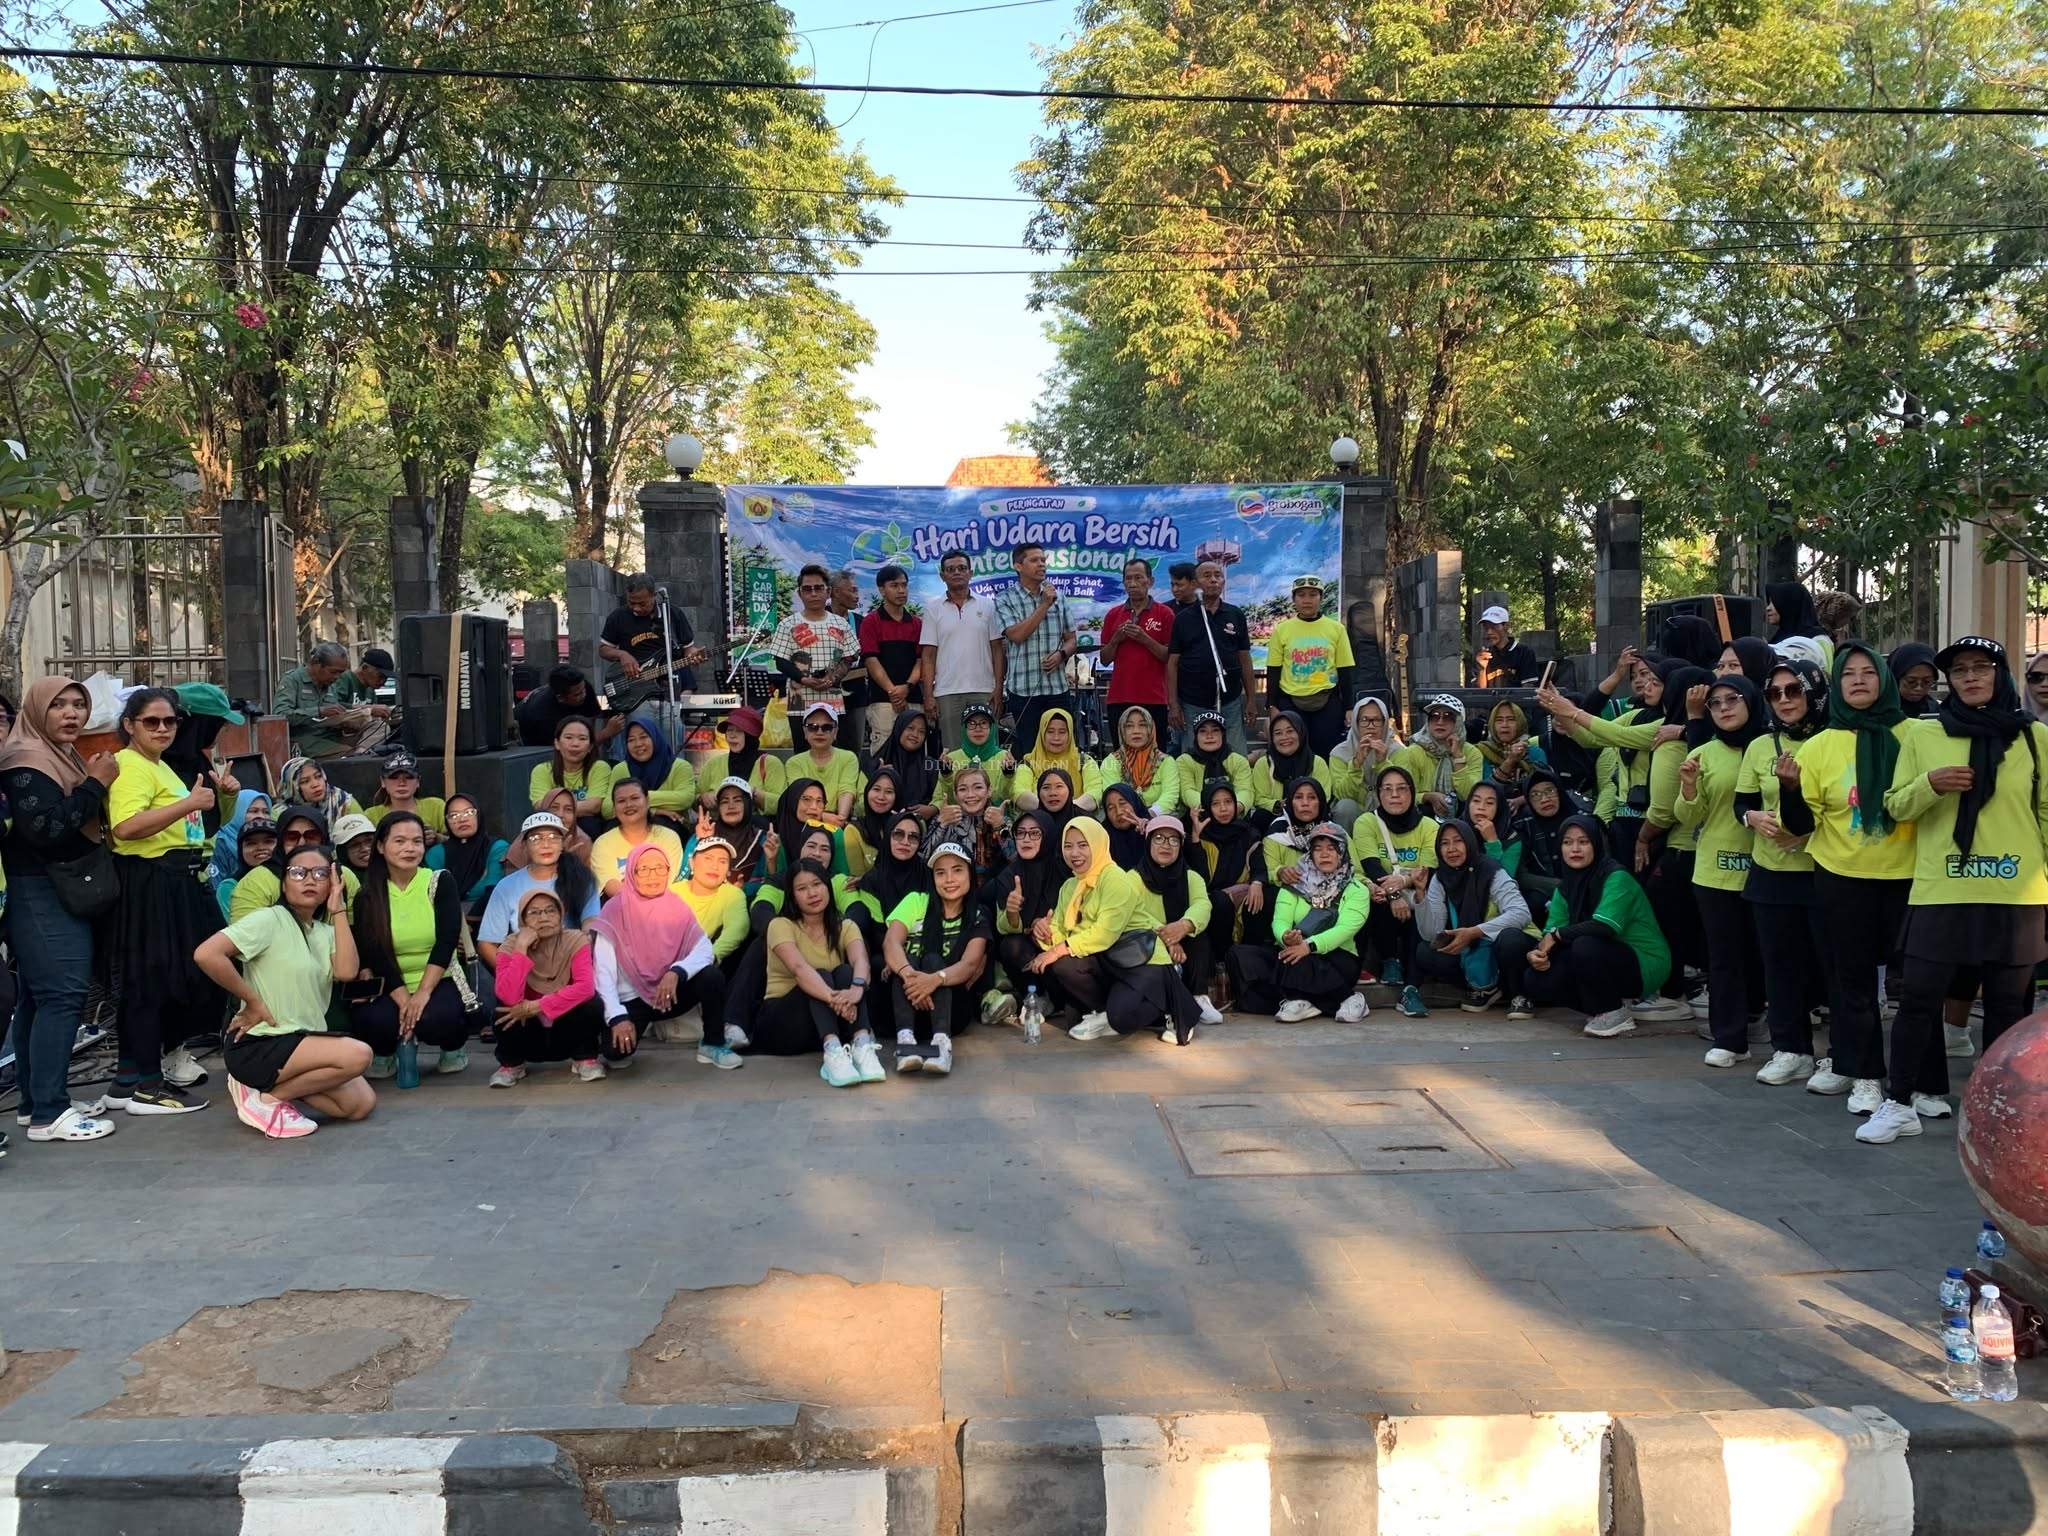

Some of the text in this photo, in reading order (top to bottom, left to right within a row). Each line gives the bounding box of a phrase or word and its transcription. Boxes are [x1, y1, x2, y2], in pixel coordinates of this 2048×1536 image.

[1007, 498, 1065, 512] PERINGATAN
[1268, 500, 1322, 511] grobogan
[913, 514, 1178, 561] Hari Udara Bersih
[753, 582, 772, 592] CAR
[1072, 576, 1104, 588] Sehat,
[1073, 586, 1095, 597] Baik
[460, 650, 470, 710] MONJAYA
[713, 697, 736, 705] KORG
[1946, 859, 2018, 879] ENNO
